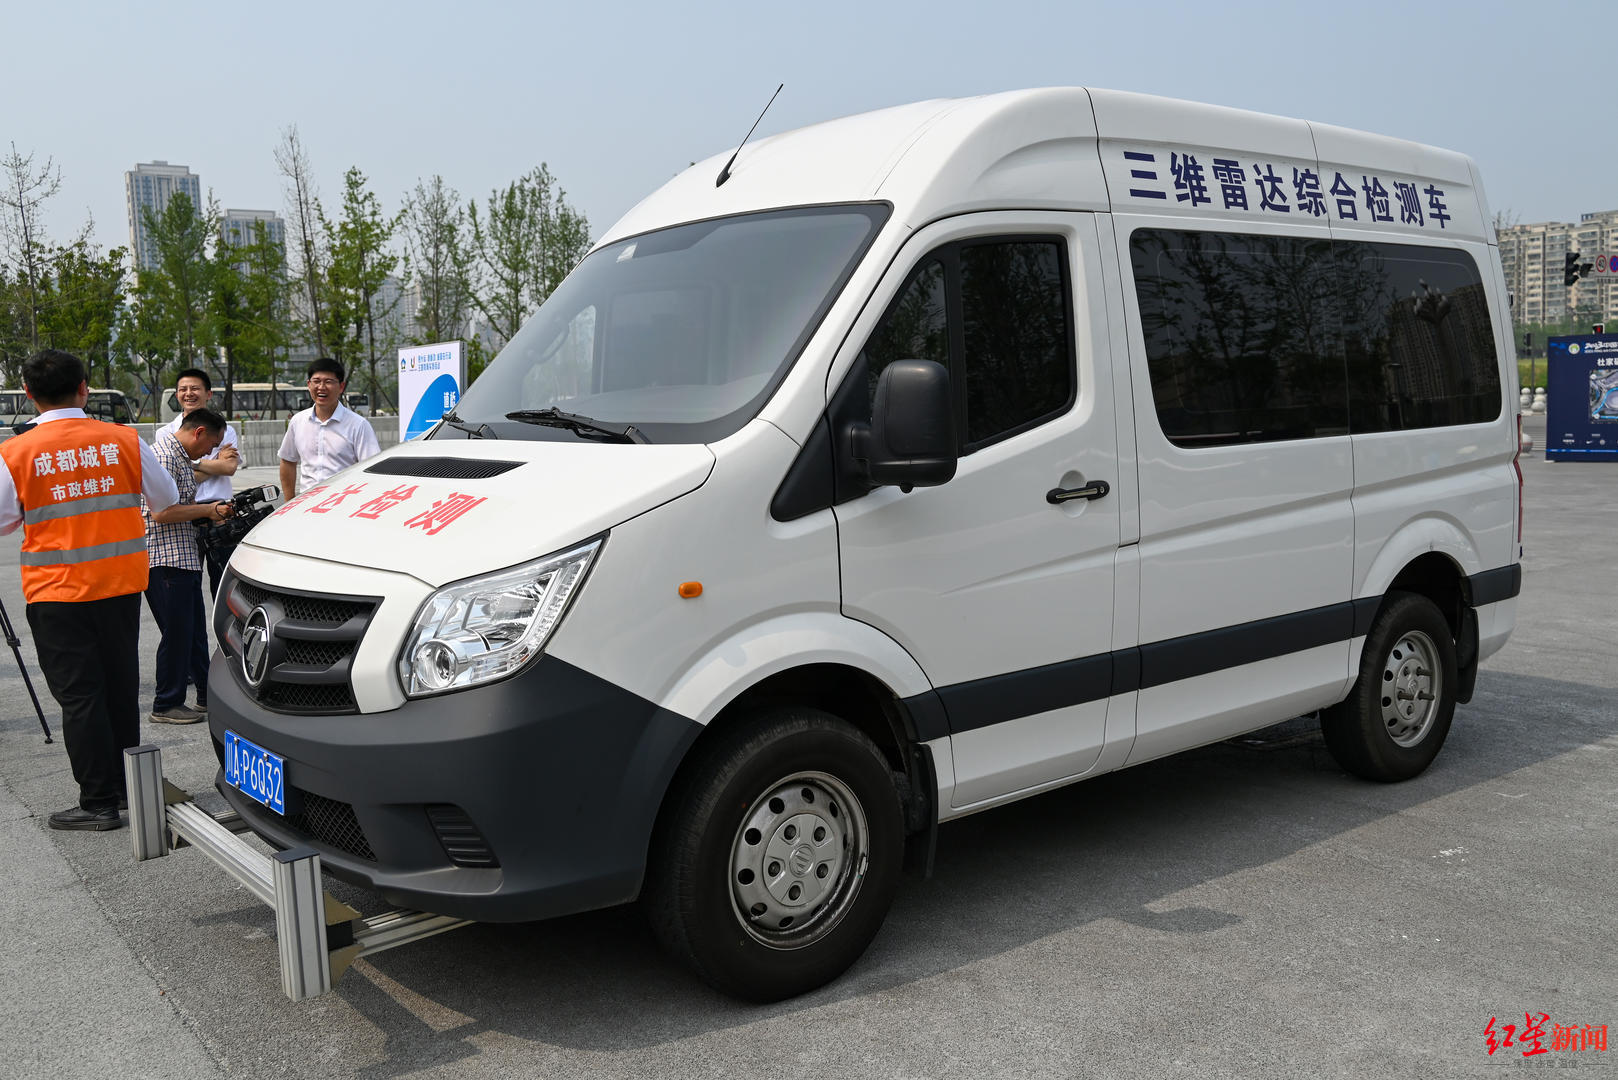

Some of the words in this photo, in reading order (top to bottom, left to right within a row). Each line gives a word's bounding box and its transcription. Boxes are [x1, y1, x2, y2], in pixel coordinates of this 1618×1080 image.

[1123, 151, 1451, 228] 三维雷达综合检测车
[34, 443, 120, 477] 成都城管
[50, 475, 115, 501] 市政维护
